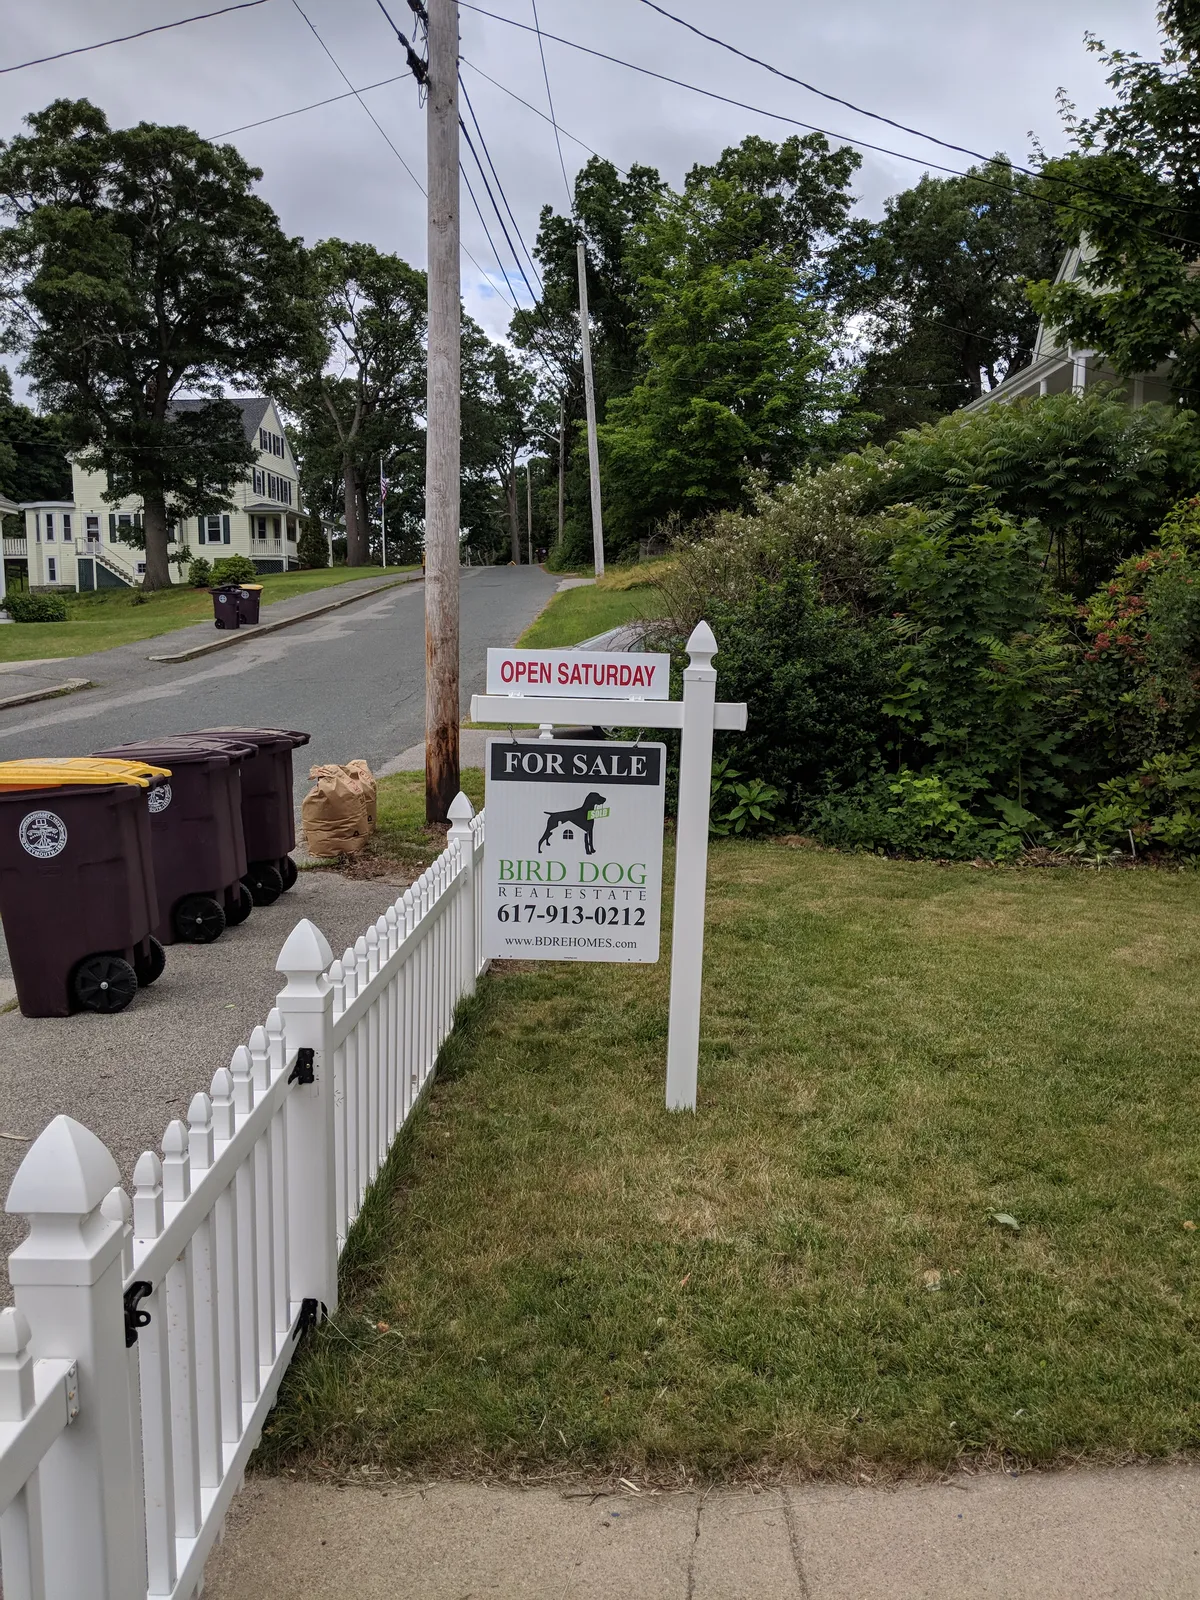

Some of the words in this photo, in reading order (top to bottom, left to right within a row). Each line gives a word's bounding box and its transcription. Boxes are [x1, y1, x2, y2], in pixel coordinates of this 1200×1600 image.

[500, 660, 552, 684] OPEN
[557, 662, 656, 687] SATURDAY
[503, 751, 565, 775] FOR
[572, 753, 647, 777] SALE
[498, 859, 567, 882] BIRD
[578, 861, 647, 885] DOG
[498, 886, 554, 899] REAL
[564, 888, 647, 901] ESTATE
[497, 903, 646, 926] 617-913-0212
[505, 936, 637, 949] www.BDREHOMES.com
